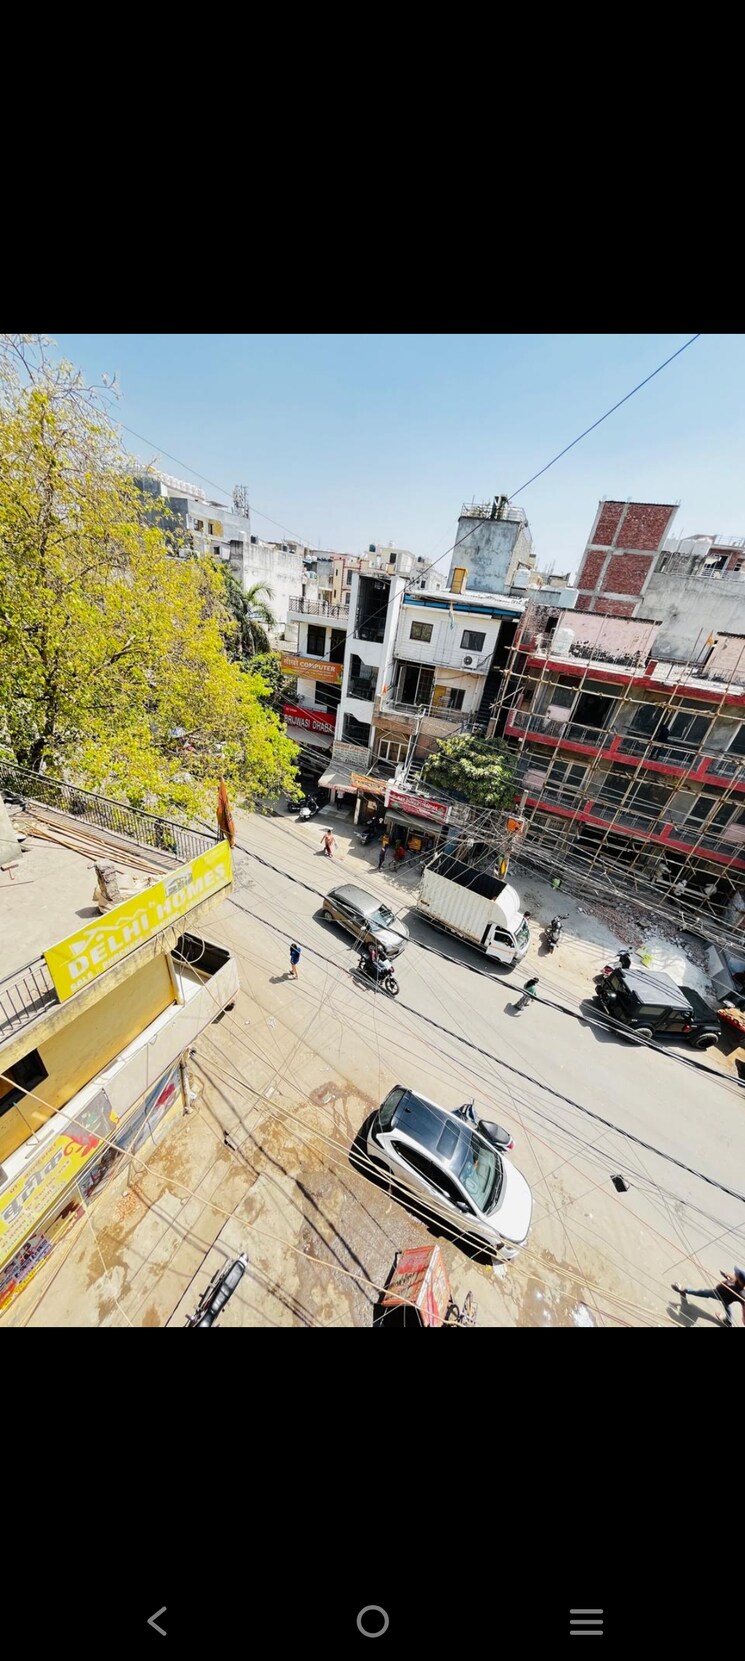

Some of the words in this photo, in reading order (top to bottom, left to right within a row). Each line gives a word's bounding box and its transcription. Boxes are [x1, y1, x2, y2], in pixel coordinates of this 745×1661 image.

[300, 660, 336, 672] COMPUTER
[67, 914, 150, 980] DELHI
[157, 863, 226, 921] HOMES
